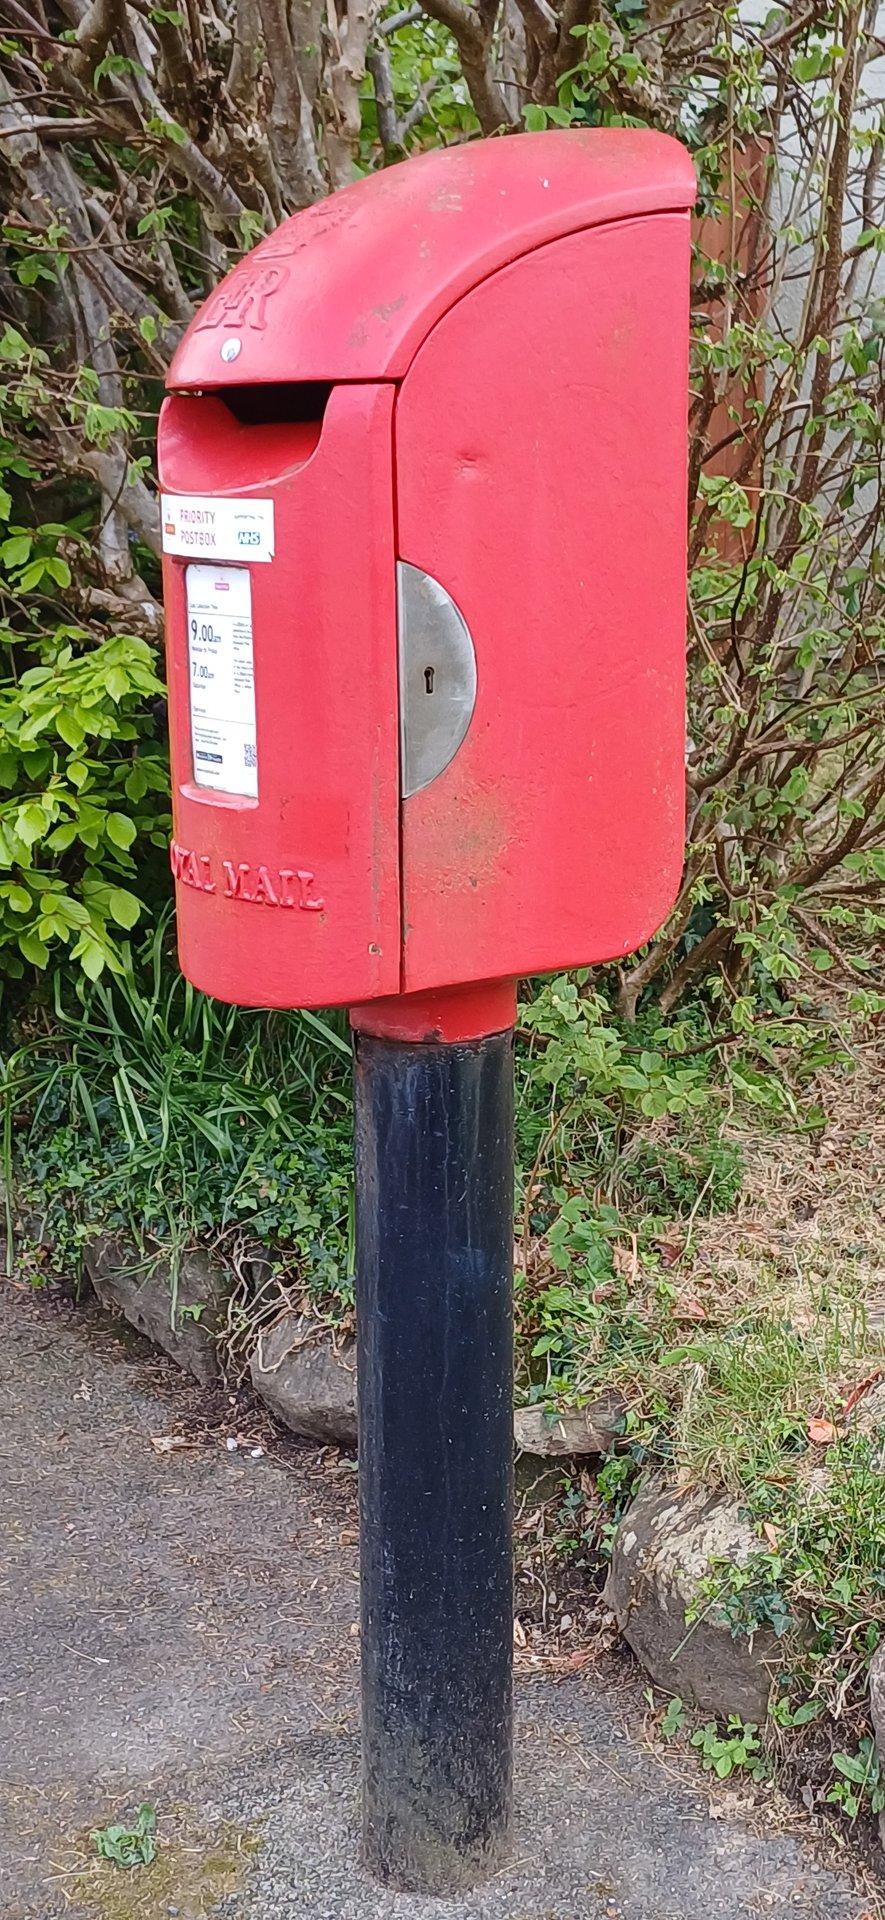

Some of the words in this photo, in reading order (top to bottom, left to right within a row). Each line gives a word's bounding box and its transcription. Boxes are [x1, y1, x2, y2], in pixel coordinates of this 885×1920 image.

[180, 509, 215, 525] PRIORITY
[180, 530, 216, 546] POSTBOX
[239, 532, 261, 545] NHS
[222, 860, 326, 911] MAIL
